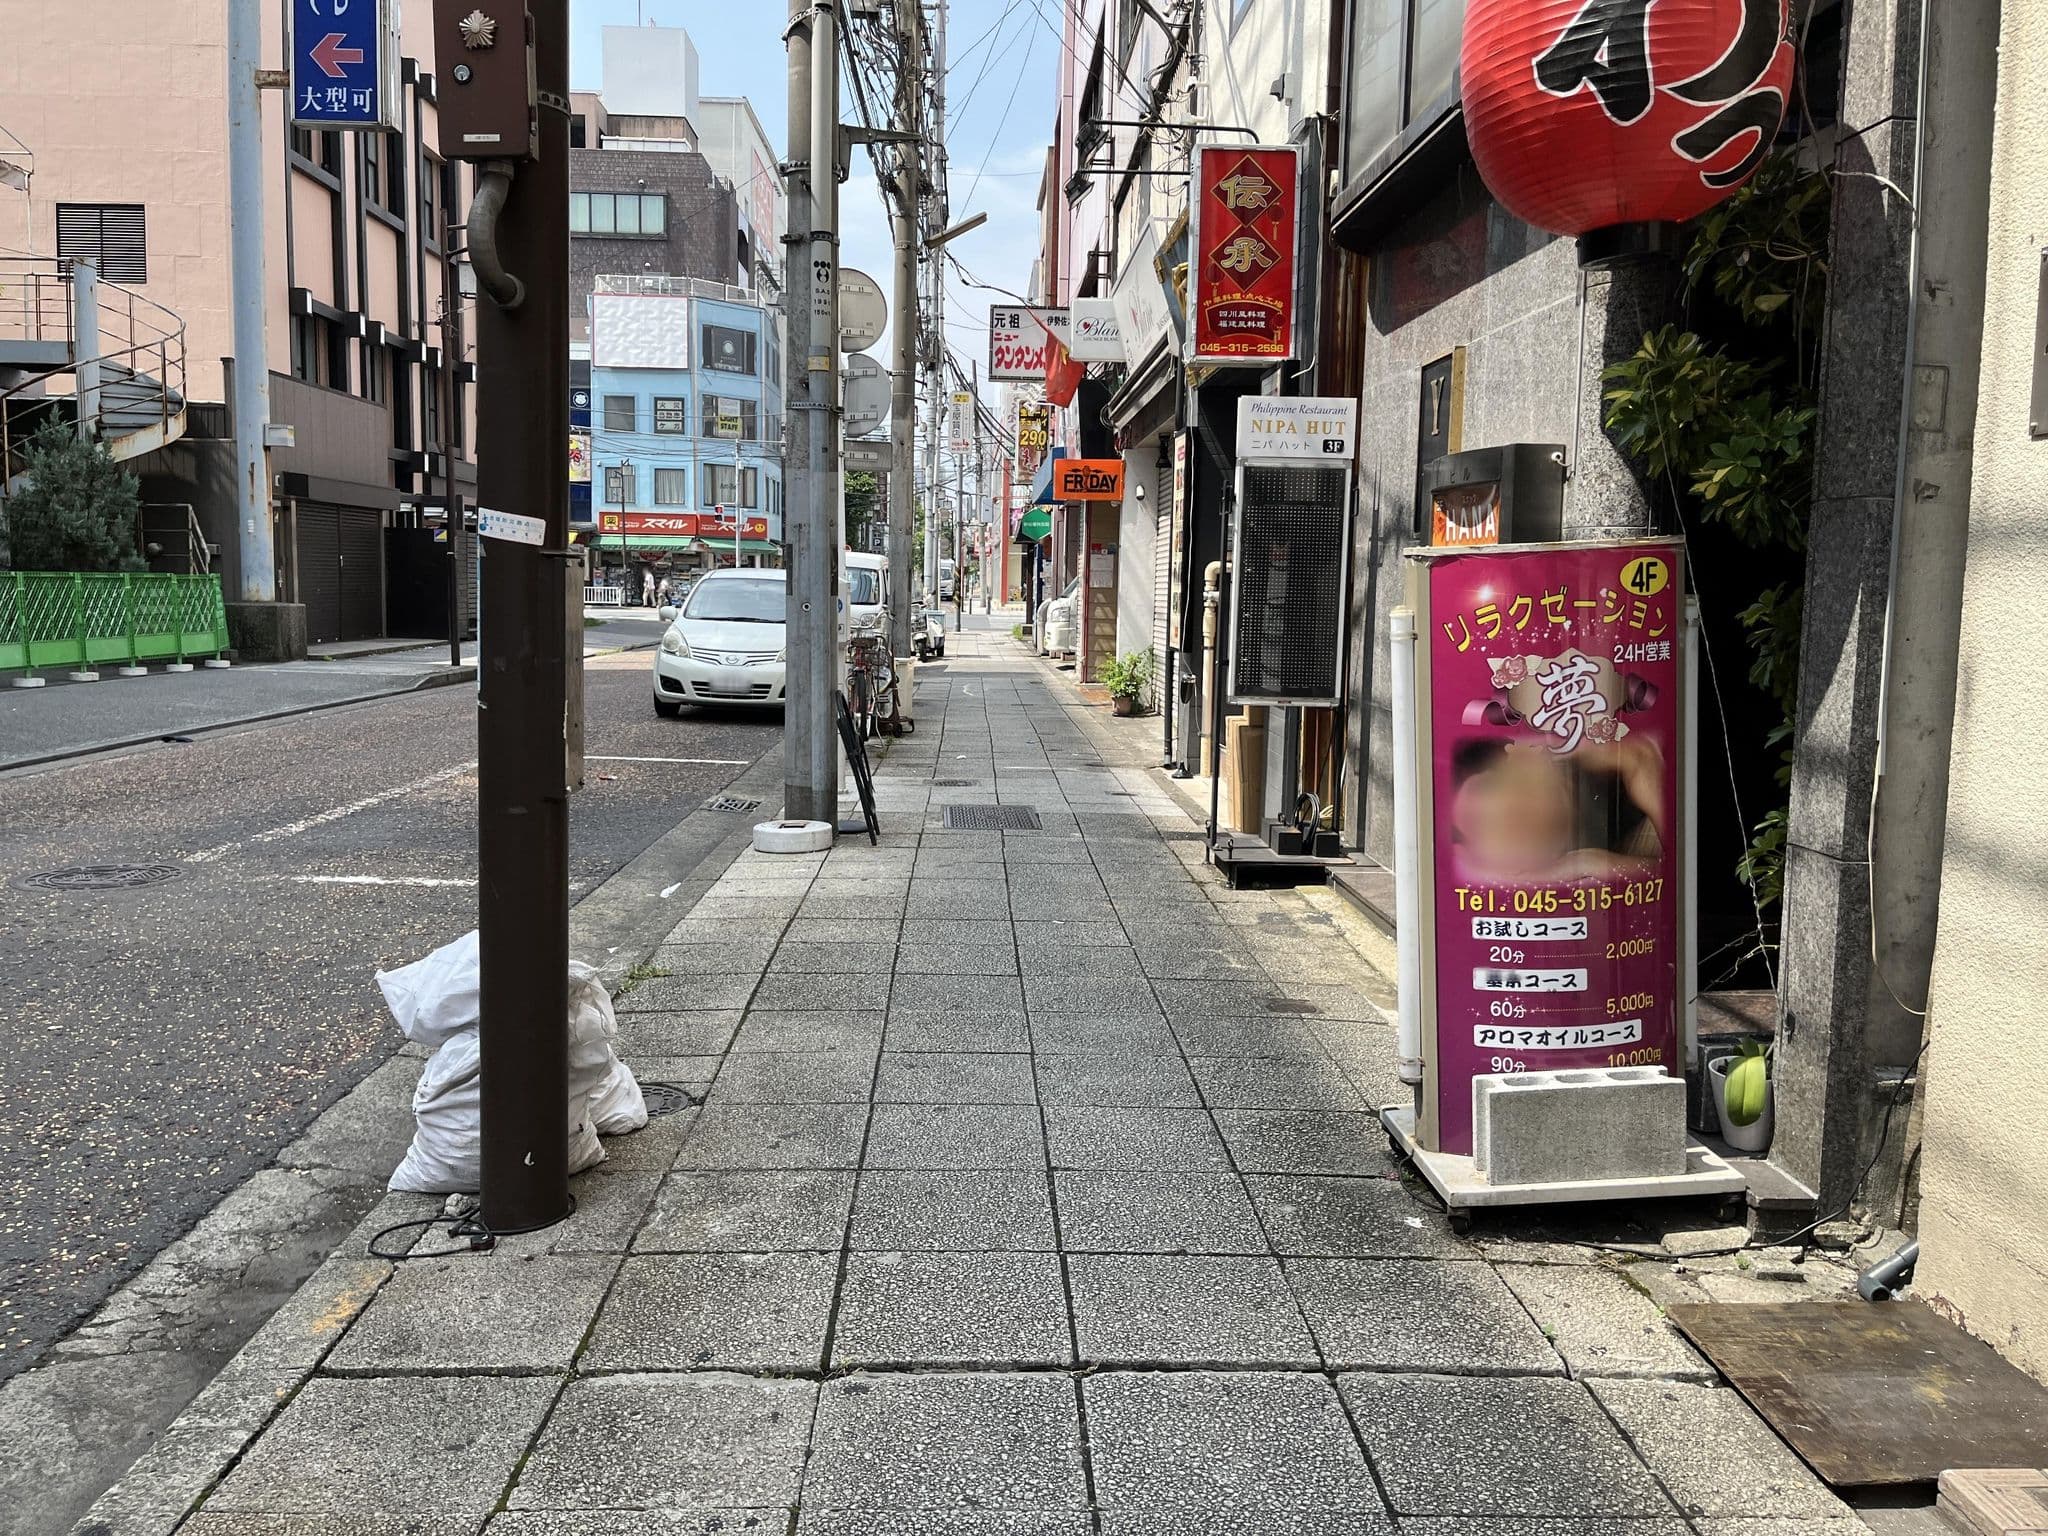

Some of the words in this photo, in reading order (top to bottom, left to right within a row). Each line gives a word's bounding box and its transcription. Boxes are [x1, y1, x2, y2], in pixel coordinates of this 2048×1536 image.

[300, 86, 374, 113] 大型可
[994, 313, 1020, 329] 元祖
[994, 332, 1019, 342] ニュー
[995, 345, 1047, 370] タンタンメ
[1251, 402, 1297, 416] Philippine
[1299, 404, 1348, 416] Restaurant
[1020, 430, 1047, 446] 290
[1251, 420, 1297, 434] NIPA
[1306, 421, 1346, 436] HUT
[1326, 441, 1342, 453] 3F
[641, 518, 689, 529] スマイル
[718, 521, 754, 532] スマル
[1445, 503, 1496, 542] HANA
[1631, 561, 1658, 593] 4F
[1443, 586, 1668, 652] リラクゼーション
[1613, 640, 1671, 664] 24H営業
[1532, 655, 1607, 754] 夢
[1475, 919, 1587, 938] お試しコース
[1489, 946, 1525, 964] 20分
[1606, 938, 1654, 960] 2,000円
[1490, 1001, 1526, 1018] 60分
[1606, 992, 1654, 1015] 5,000円
[1479, 1024, 1637, 1046] アロマオイルコース
[1490, 1057, 1527, 1073] 90分
